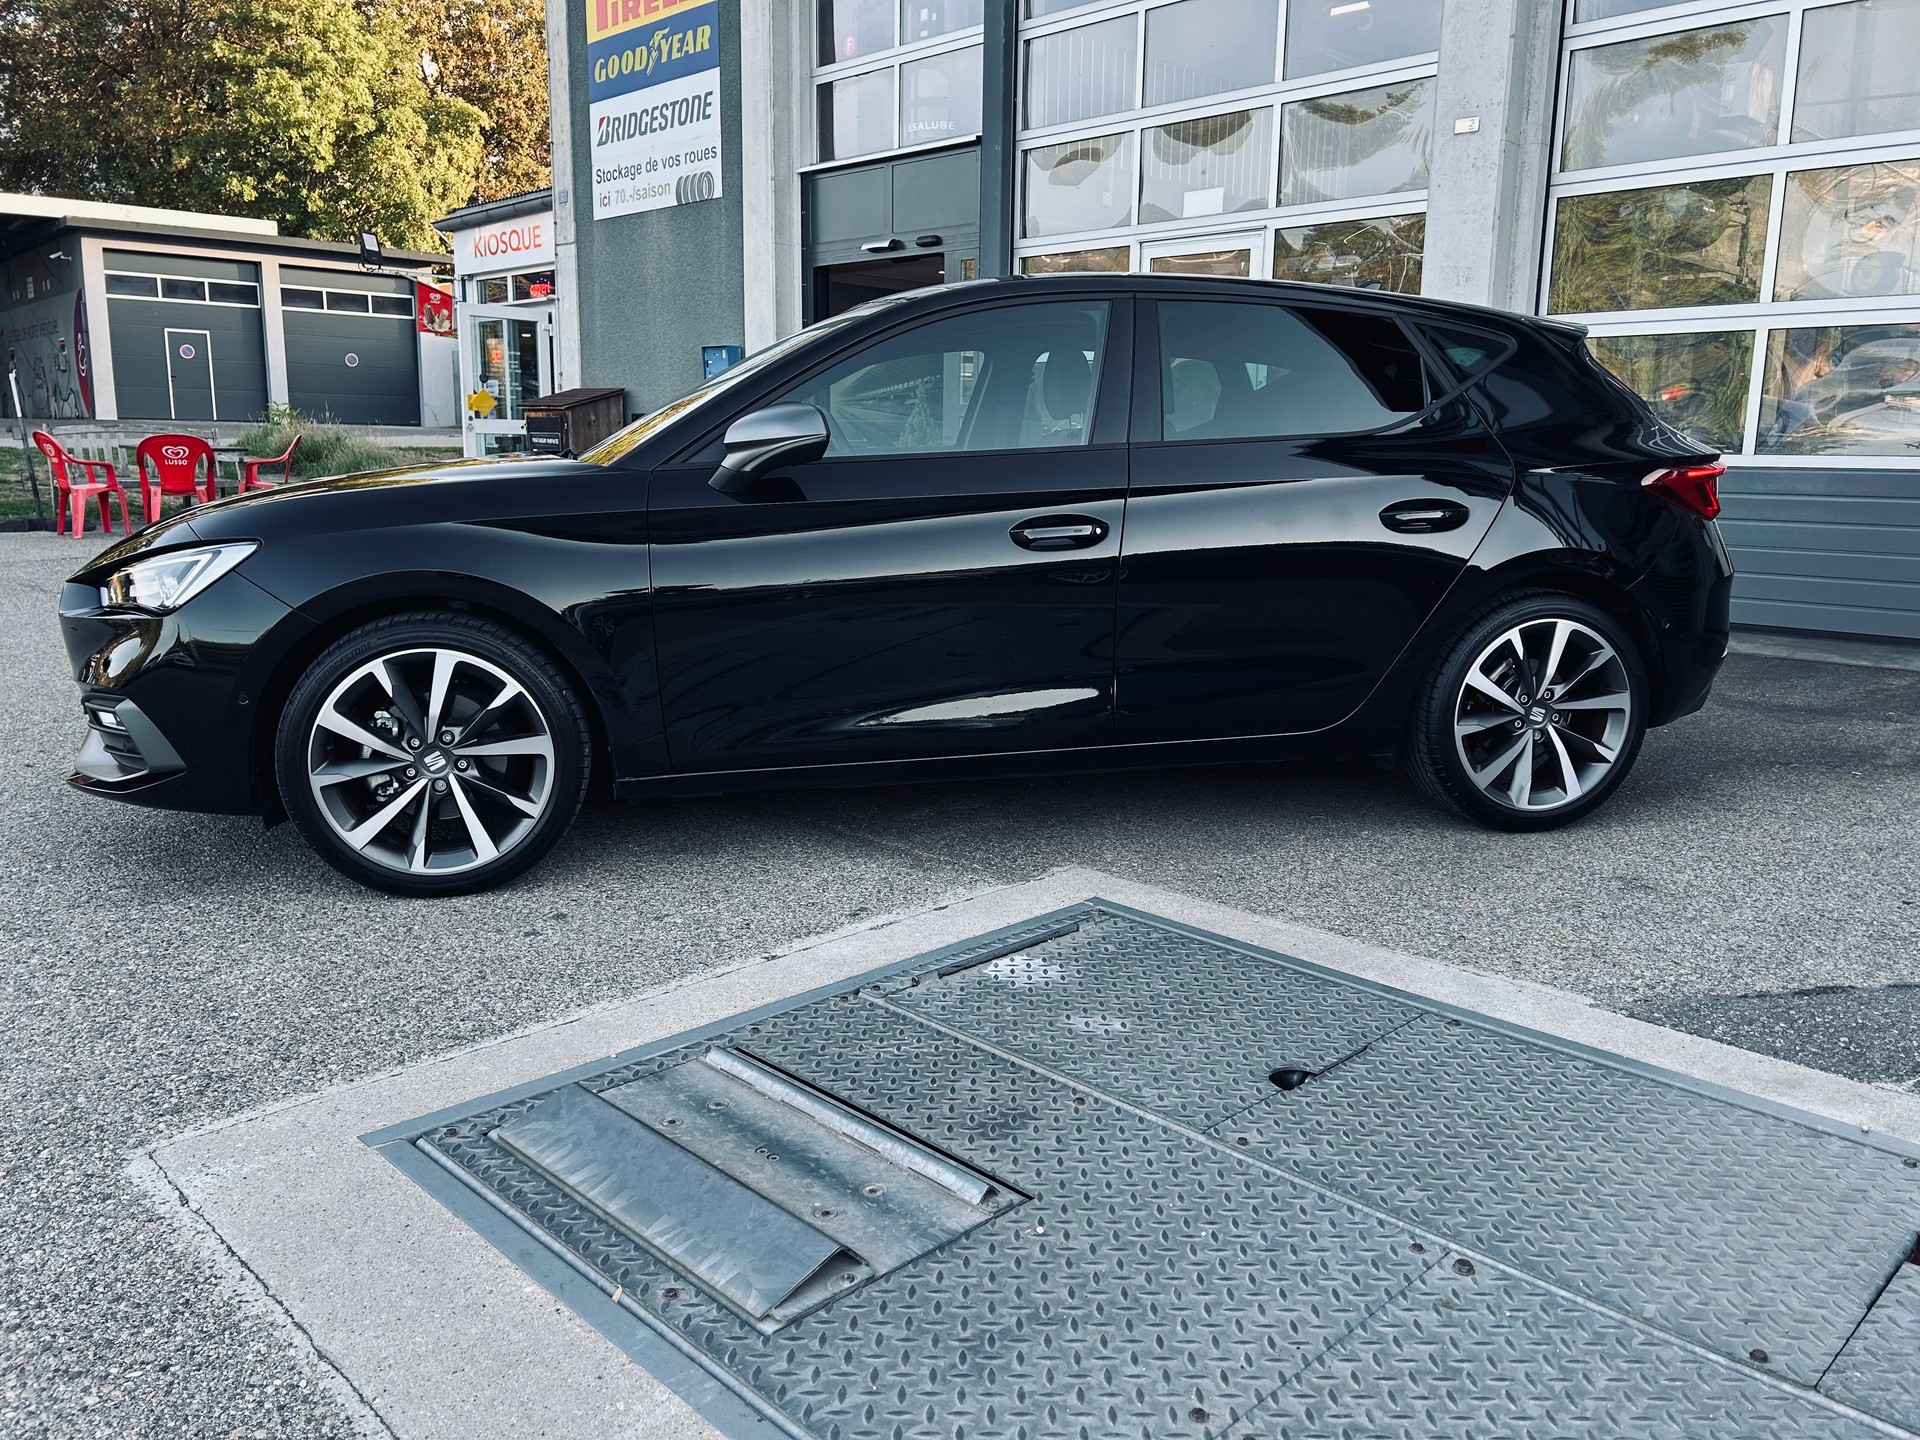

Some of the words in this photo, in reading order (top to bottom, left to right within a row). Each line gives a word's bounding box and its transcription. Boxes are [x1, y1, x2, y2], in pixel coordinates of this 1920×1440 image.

[594, 24, 711, 83] GOODYEAR
[597, 91, 713, 147] BRIDGESTONE
[596, 162, 642, 184] Stockage
[645, 157, 658, 173] de
[661, 154, 681, 169] vos
[684, 146, 718, 165] roues
[599, 193, 611, 208] ici
[473, 225, 542, 258] KIOSQUE
